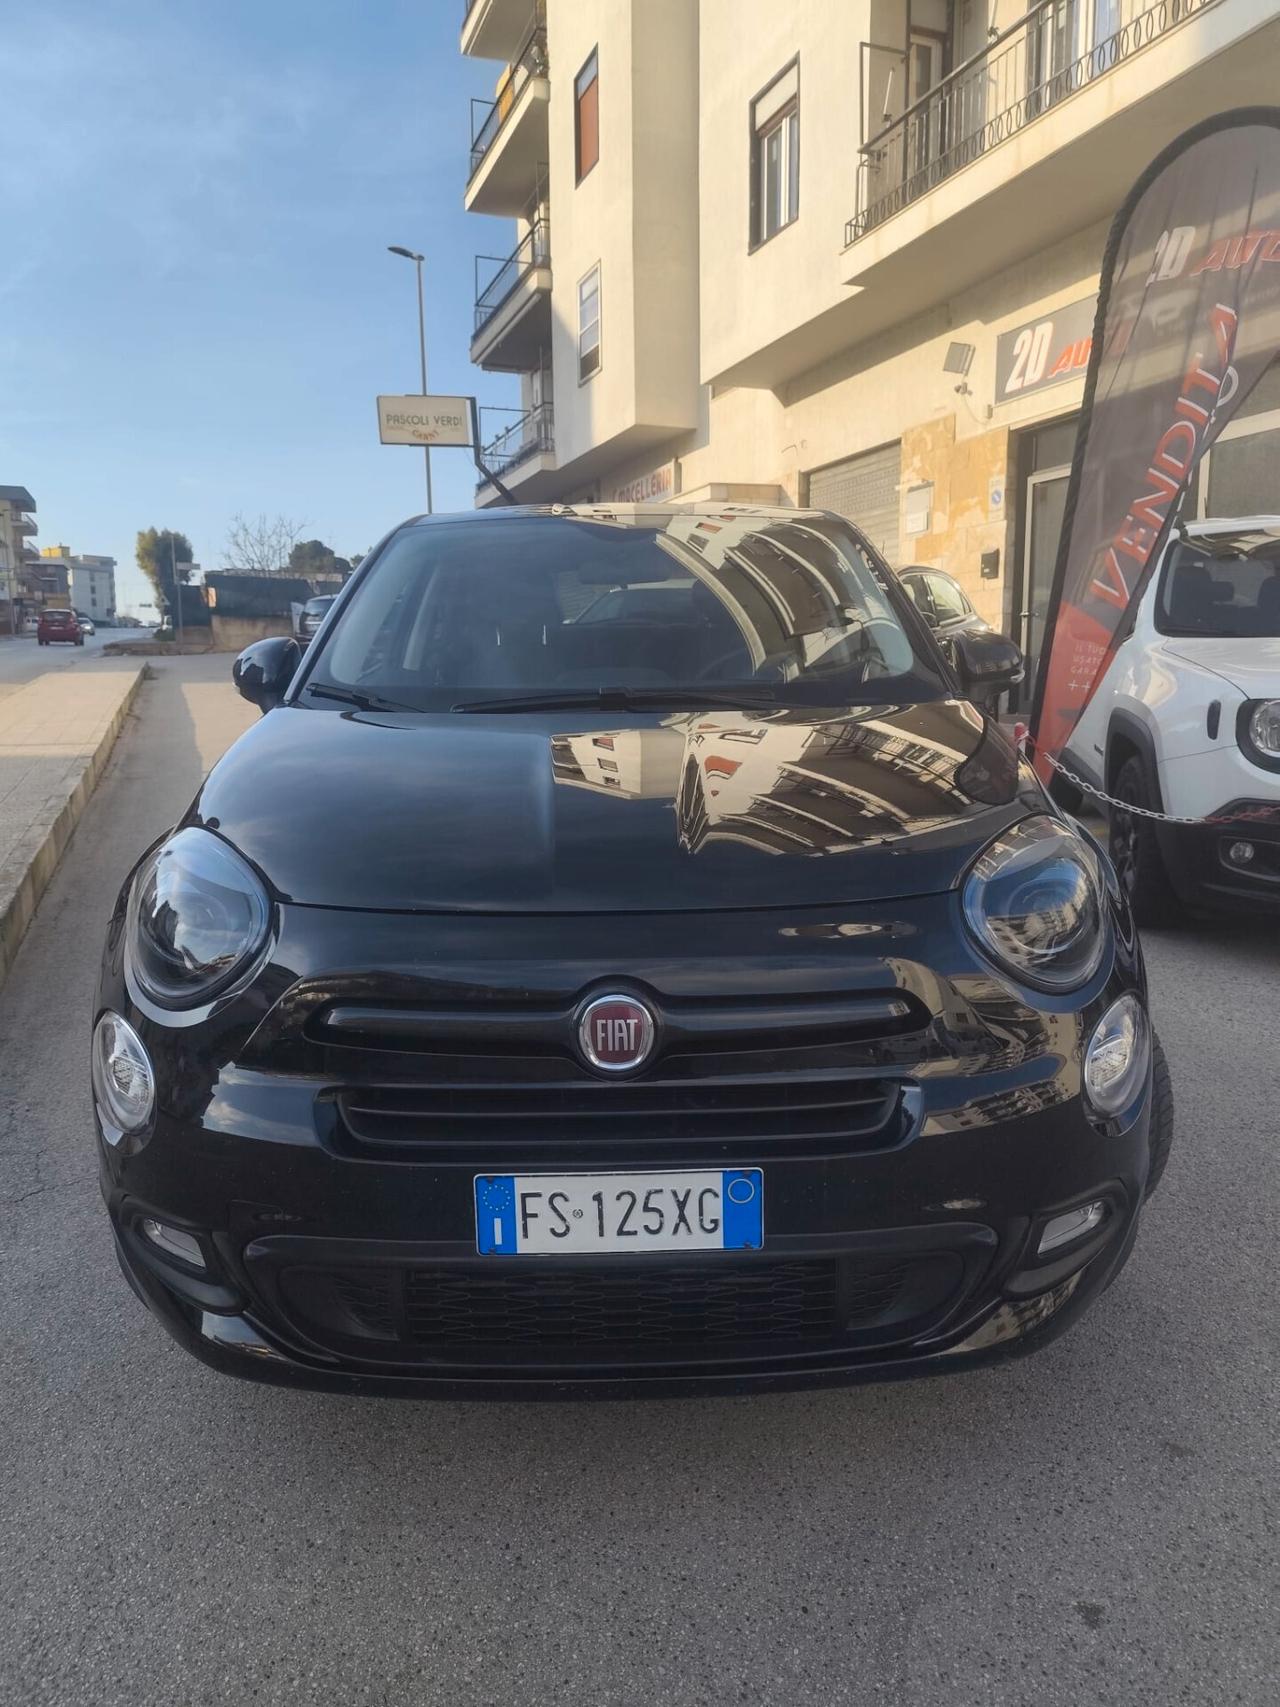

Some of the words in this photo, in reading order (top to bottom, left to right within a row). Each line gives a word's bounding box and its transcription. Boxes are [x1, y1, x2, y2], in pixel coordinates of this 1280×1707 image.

[1047, 335, 1094, 379] AU
[385, 413, 430, 426] PASCOLI
[433, 415, 464, 427] VERDI
[596, 1018, 639, 1051] FIAT
[520, 1191, 571, 1239] FS
[592, 1188, 721, 1238] 125XG
